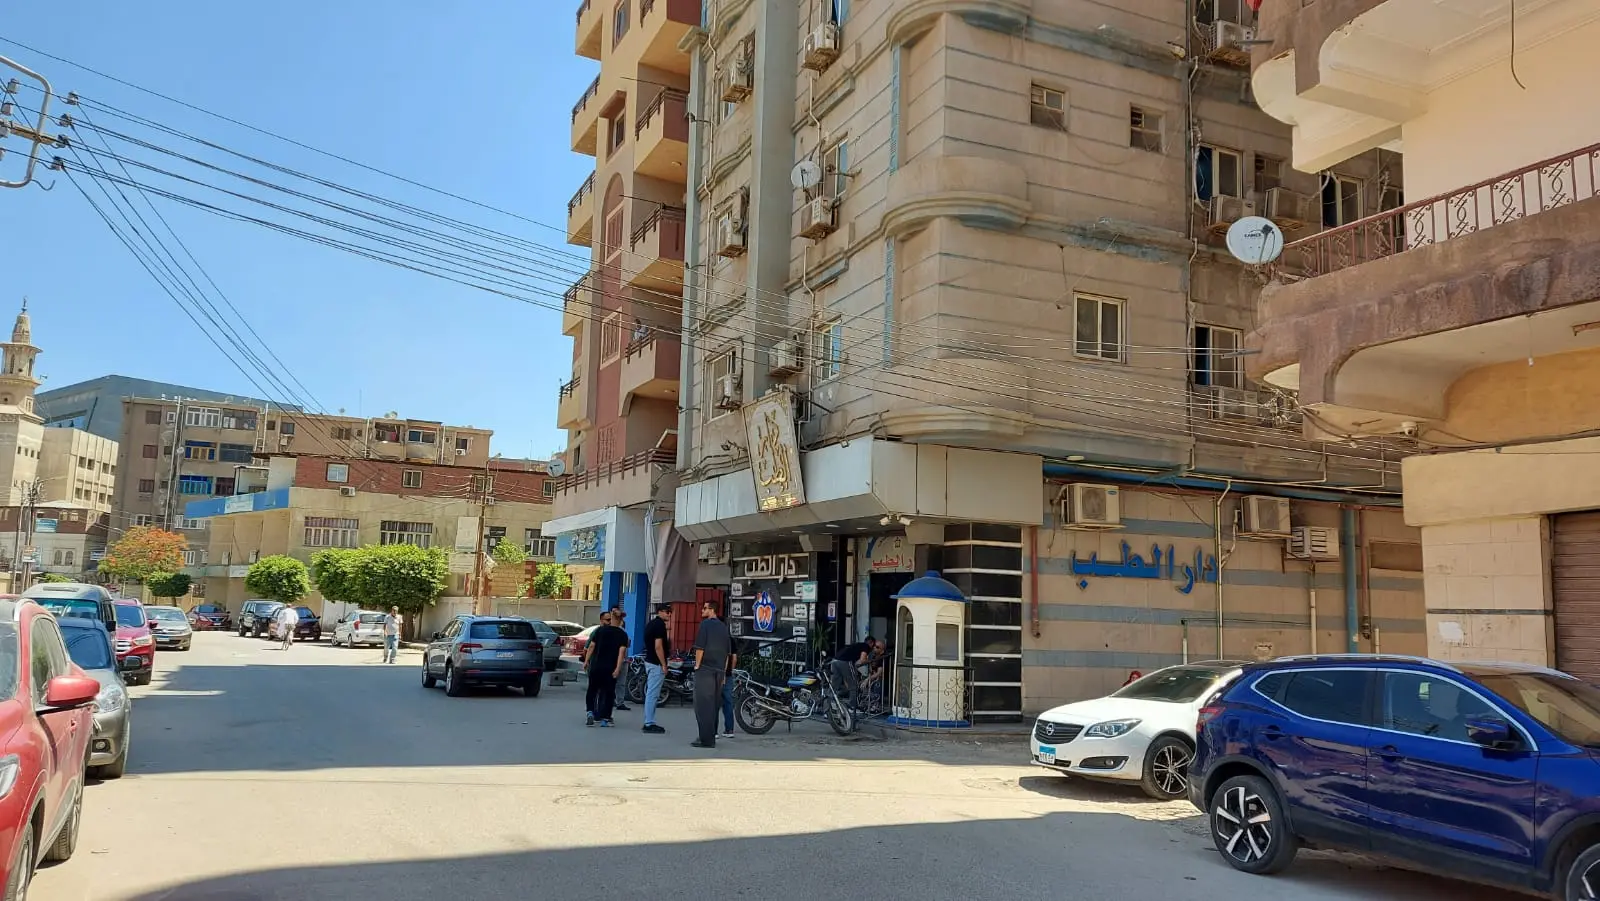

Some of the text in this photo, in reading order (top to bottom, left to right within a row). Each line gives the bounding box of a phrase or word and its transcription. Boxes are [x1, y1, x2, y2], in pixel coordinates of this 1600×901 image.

[744, 554, 796, 586] دار الطب
[1070, 539, 1217, 594] دار الطب
